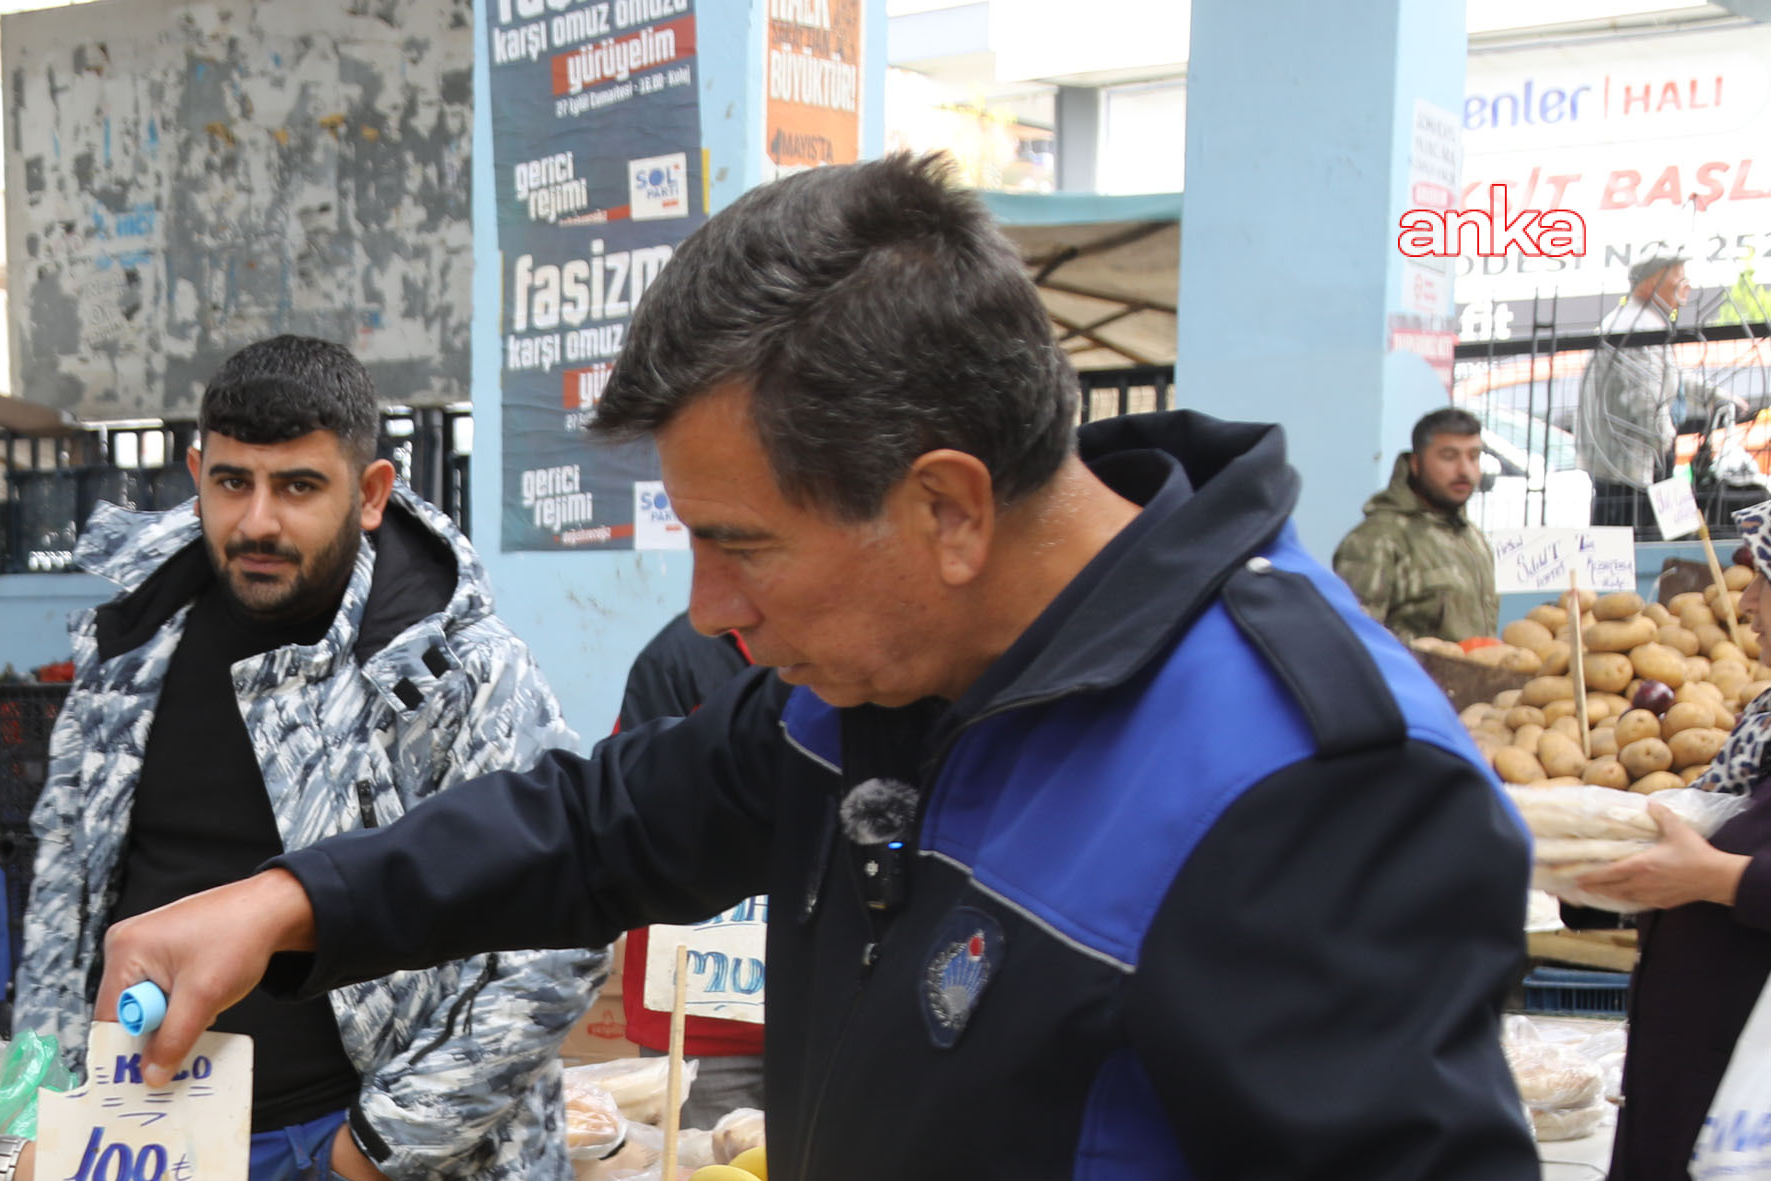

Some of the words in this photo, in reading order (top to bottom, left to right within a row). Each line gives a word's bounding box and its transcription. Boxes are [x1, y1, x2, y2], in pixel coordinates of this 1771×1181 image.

[493, 20, 548, 65] karşı
[552, 3, 611, 47] omuz
[566, 26, 677, 95] yürüyelim
[1623, 75, 1724, 115] HALI
[514, 151, 575, 202] gerici
[529, 177, 589, 225] rejimi
[1598, 158, 1771, 212] BAŞL
[507, 334, 561, 373] karşı
[564, 323, 625, 362] omuz
[522, 464, 580, 508] gerici
[535, 491, 593, 532] rejimi
